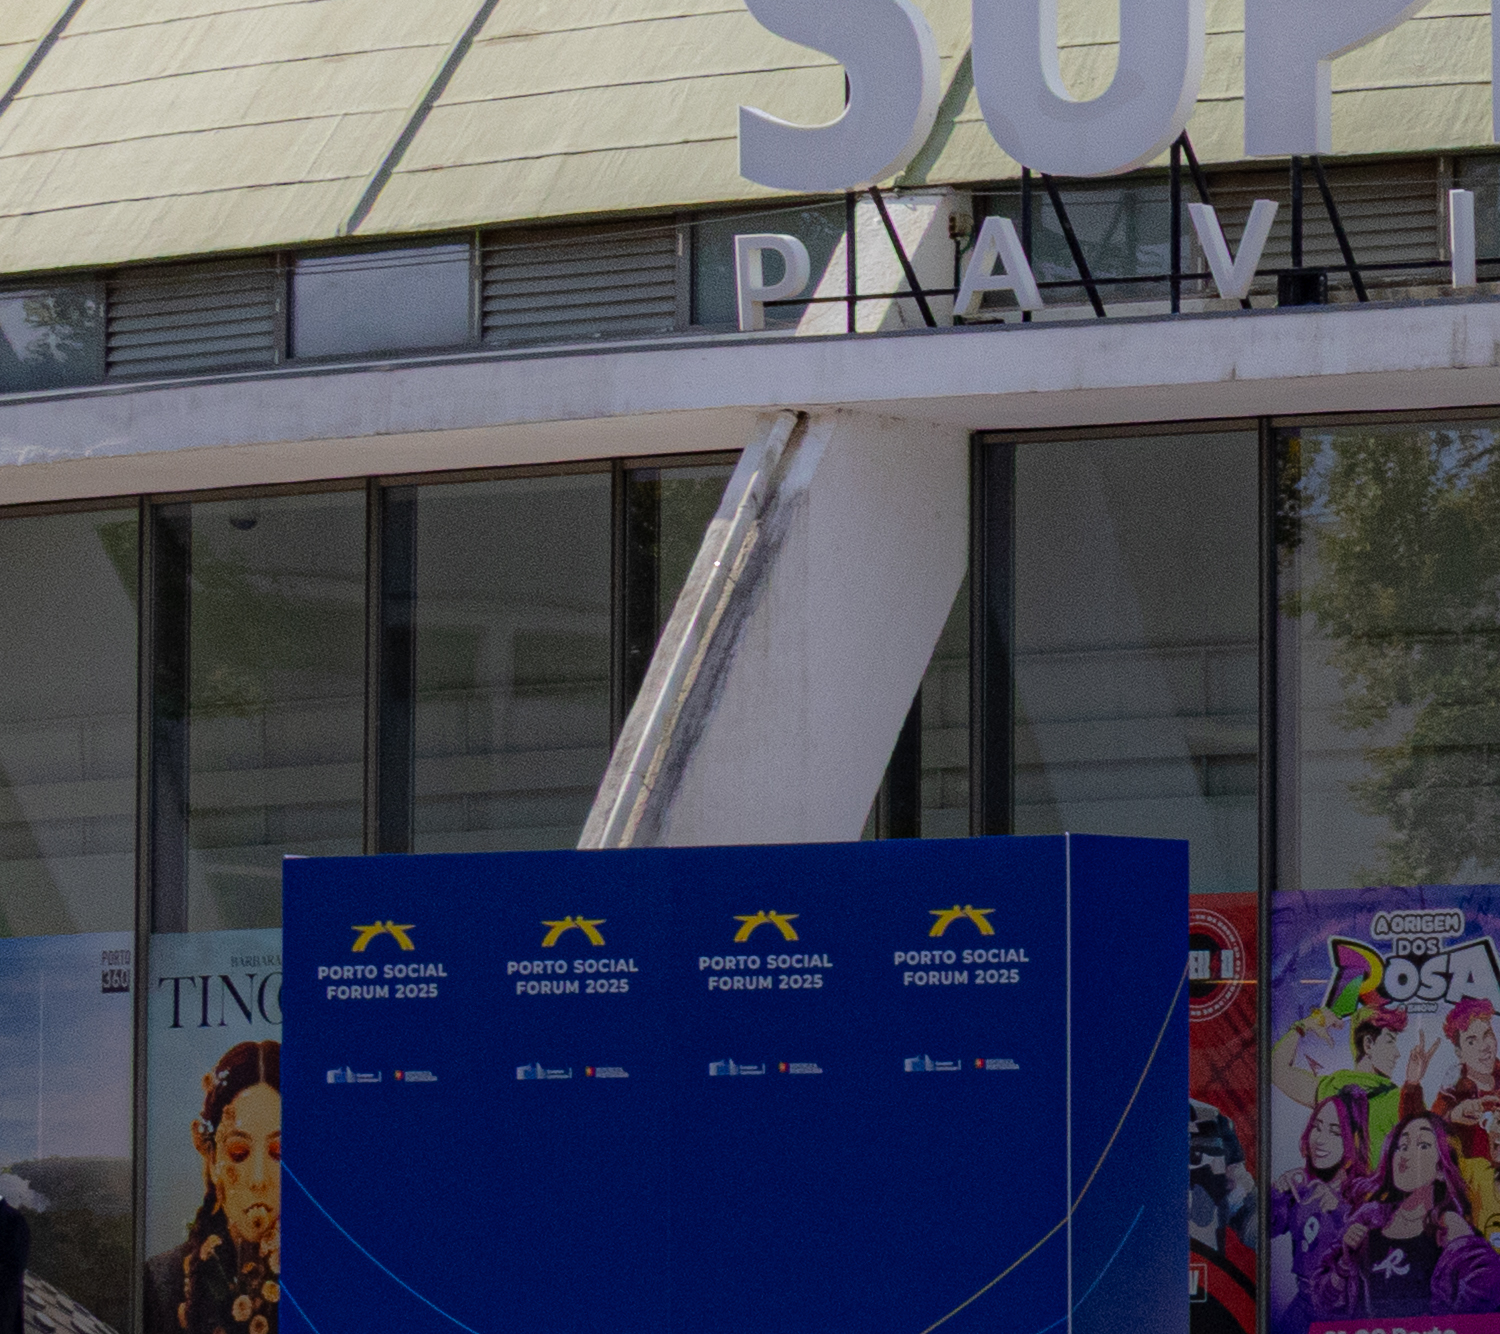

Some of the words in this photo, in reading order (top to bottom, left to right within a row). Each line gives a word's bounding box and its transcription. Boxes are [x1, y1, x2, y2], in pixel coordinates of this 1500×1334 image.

[1375, 916, 1389, 934] A
[1389, 913, 1461, 933] ORIGEM
[1397, 938, 1440, 956] DOS
[698, 955, 761, 971] PORTO
[766, 954, 833, 969] SOCIAL
[894, 950, 957, 966] PORTO
[962, 948, 1029, 964] SOCIAL
[317, 965, 378, 980] PORTO
[383, 963, 448, 979] SOCIAL
[507, 960, 568, 976] PORTO
[573, 958, 639, 973] SOCIAL
[708, 975, 773, 991] FORUM
[779, 974, 823, 990] 2025
[903, 970, 969, 986] FORUM
[974, 969, 1020, 984] 2025
[326, 984, 389, 1000] FORUM
[395, 983, 438, 999] 2025
[516, 980, 580, 995] FORUM
[585, 978, 630, 994] 2025
